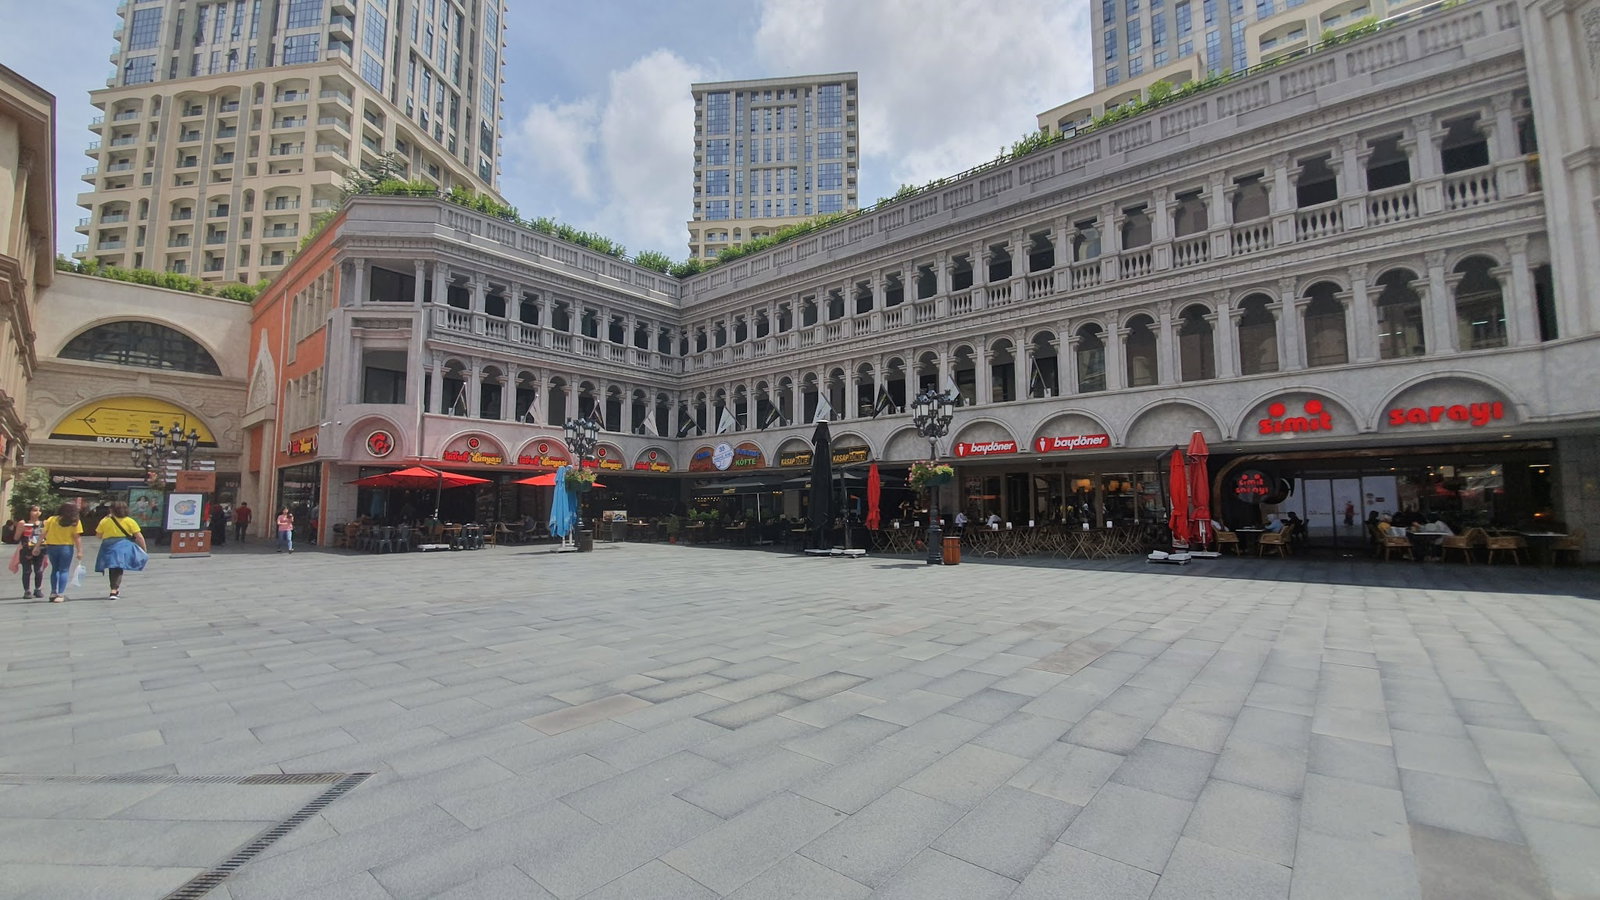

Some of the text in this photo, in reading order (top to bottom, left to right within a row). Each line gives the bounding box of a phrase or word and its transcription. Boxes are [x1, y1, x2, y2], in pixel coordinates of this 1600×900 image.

[1258, 400, 1504, 434] simit sarayı
[971, 441, 1014, 455] baydöner
[1054, 435, 1105, 450] baydöner
